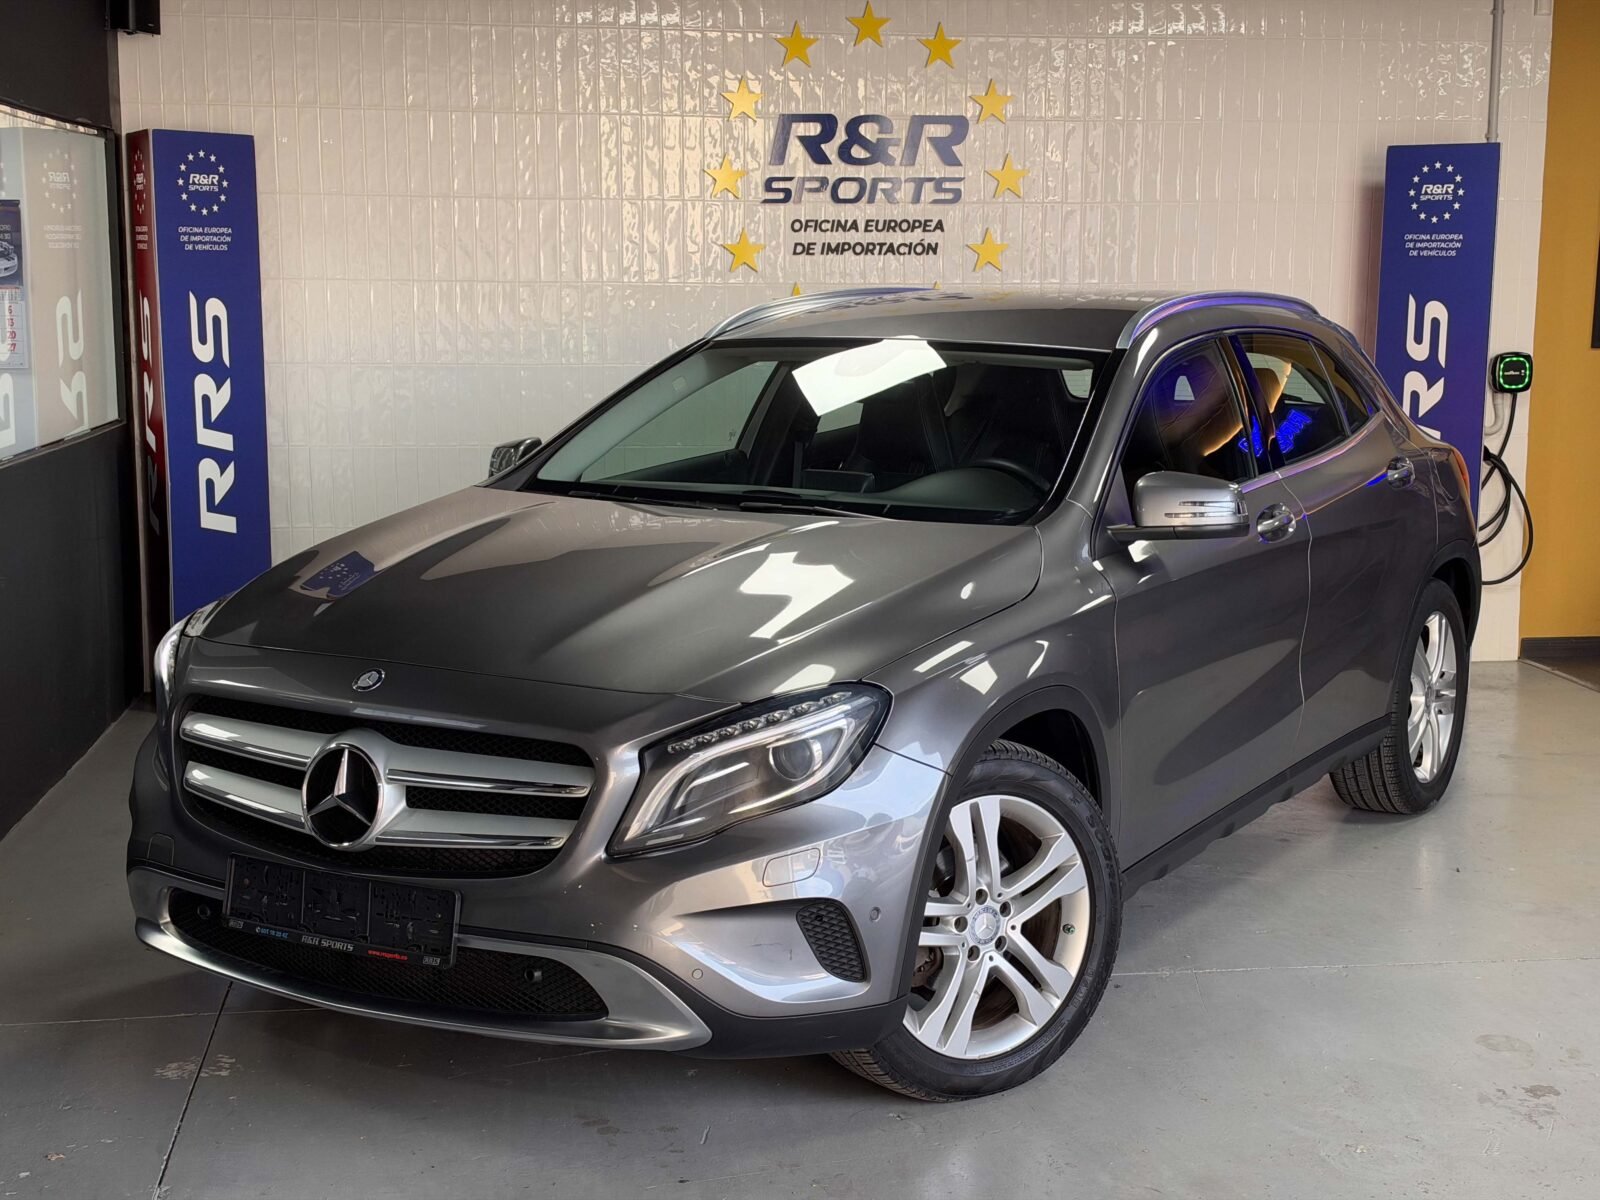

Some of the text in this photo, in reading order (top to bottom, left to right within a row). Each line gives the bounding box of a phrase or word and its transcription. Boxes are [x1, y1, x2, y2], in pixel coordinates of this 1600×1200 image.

[769, 113, 969, 167] R&R
[189, 173, 219, 185] R&R
[760, 176, 966, 204] SPORTS
[1421, 184, 1455, 195] R&R
[790, 218, 945, 233] OFICINA EUROPEA
[184, 243, 228, 251] DE VEHÍCULOS
[792, 239, 939, 256] DE IMPORTACIÓN
[1408, 249, 1457, 257] DE VEHÍCULOS
[1402, 293, 1449, 440] RS
[189, 290, 238, 534] RRS
[320, 938, 354, 952] SPORTS
